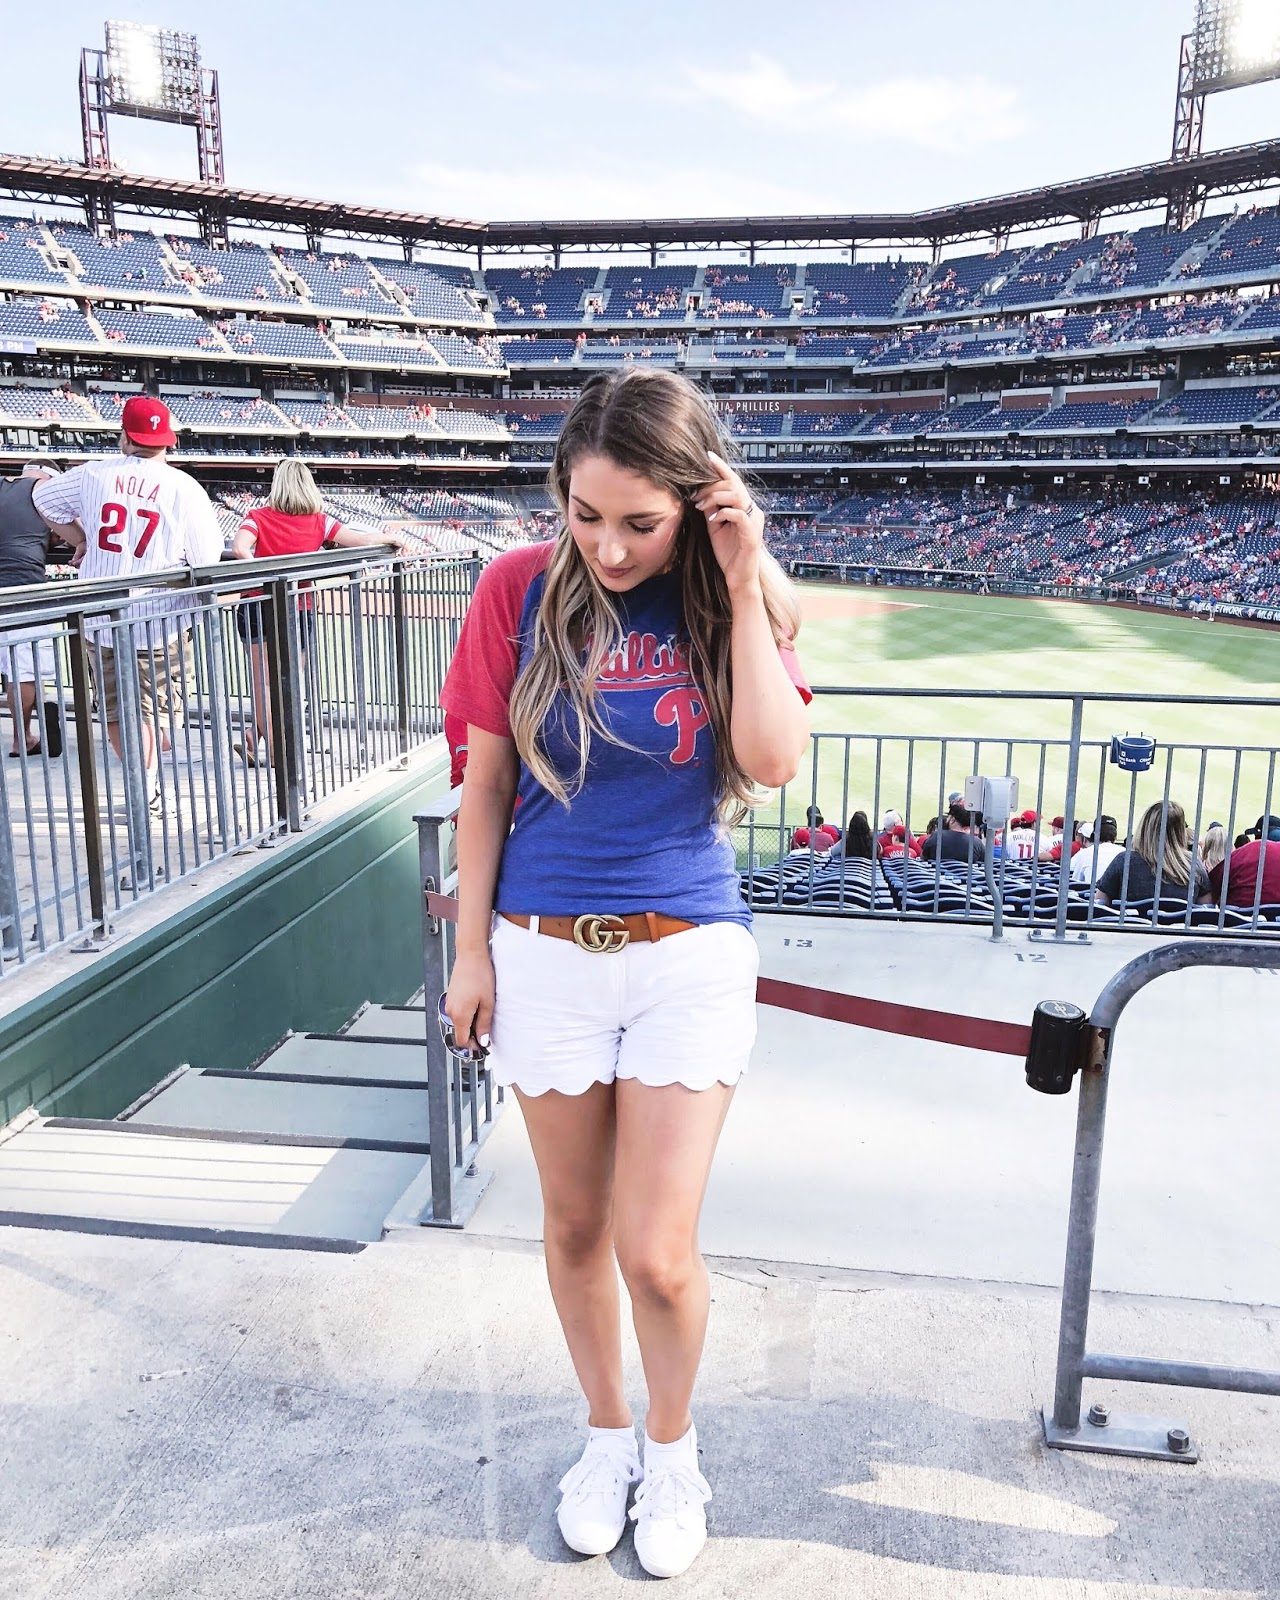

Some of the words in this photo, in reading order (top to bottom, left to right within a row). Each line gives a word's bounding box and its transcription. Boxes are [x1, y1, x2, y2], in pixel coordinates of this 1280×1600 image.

[736, 401, 780, 411] PHILLIES
[150, 415, 161, 430] P
[115, 475, 161, 503] NOLA
[98, 502, 161, 559] 27
[1215, 603, 1244, 617] ETWORK
[1256, 609, 1274, 620] MLB
[654, 686, 710, 765] P
[1018, 843, 1033, 859] 11
[783, 938, 813, 948] 13
[1014, 952, 1049, 963] 12
